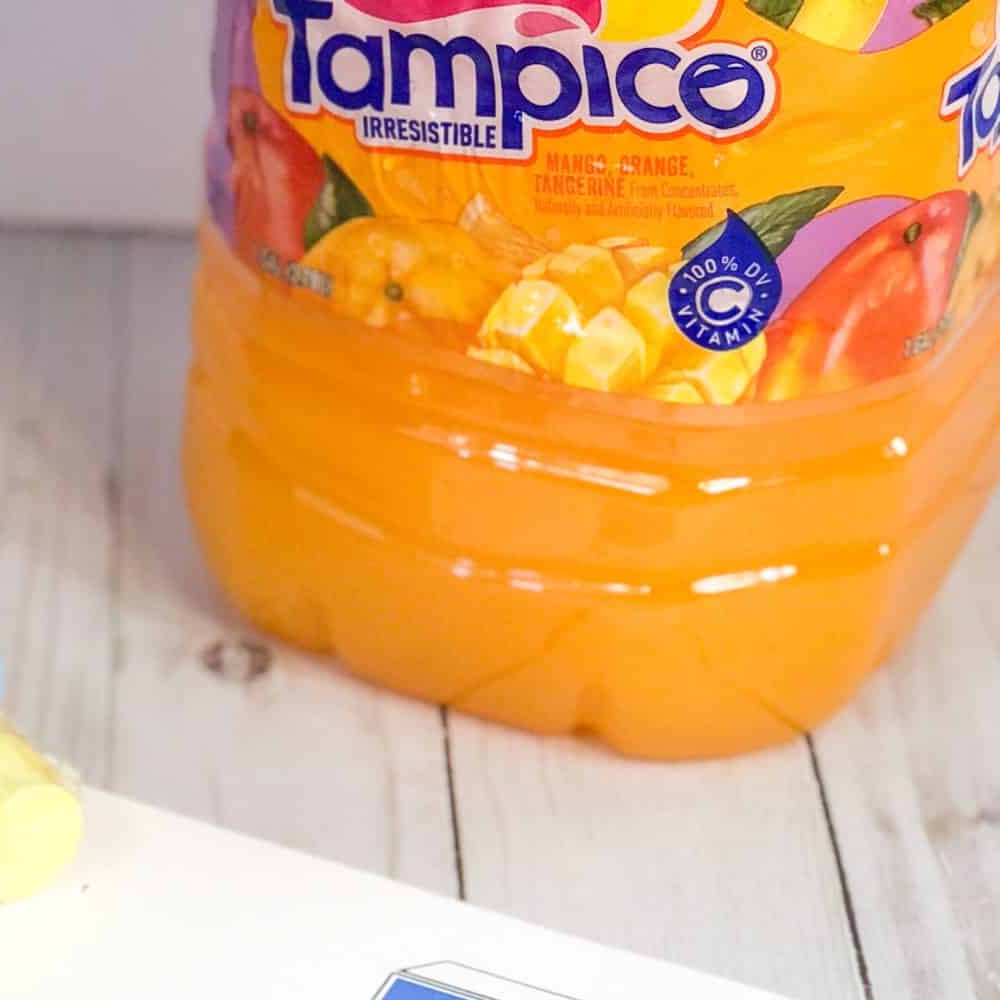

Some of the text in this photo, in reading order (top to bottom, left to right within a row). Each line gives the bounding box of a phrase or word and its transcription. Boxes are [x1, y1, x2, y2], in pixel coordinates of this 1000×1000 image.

[362, 115, 497, 149] IRRESISTIBLE
[535, 174, 625, 198] TANGERINE
[743, 262, 773, 287] DV
[698, 278, 749, 325] C
[677, 304, 766, 346] VITAMIN
